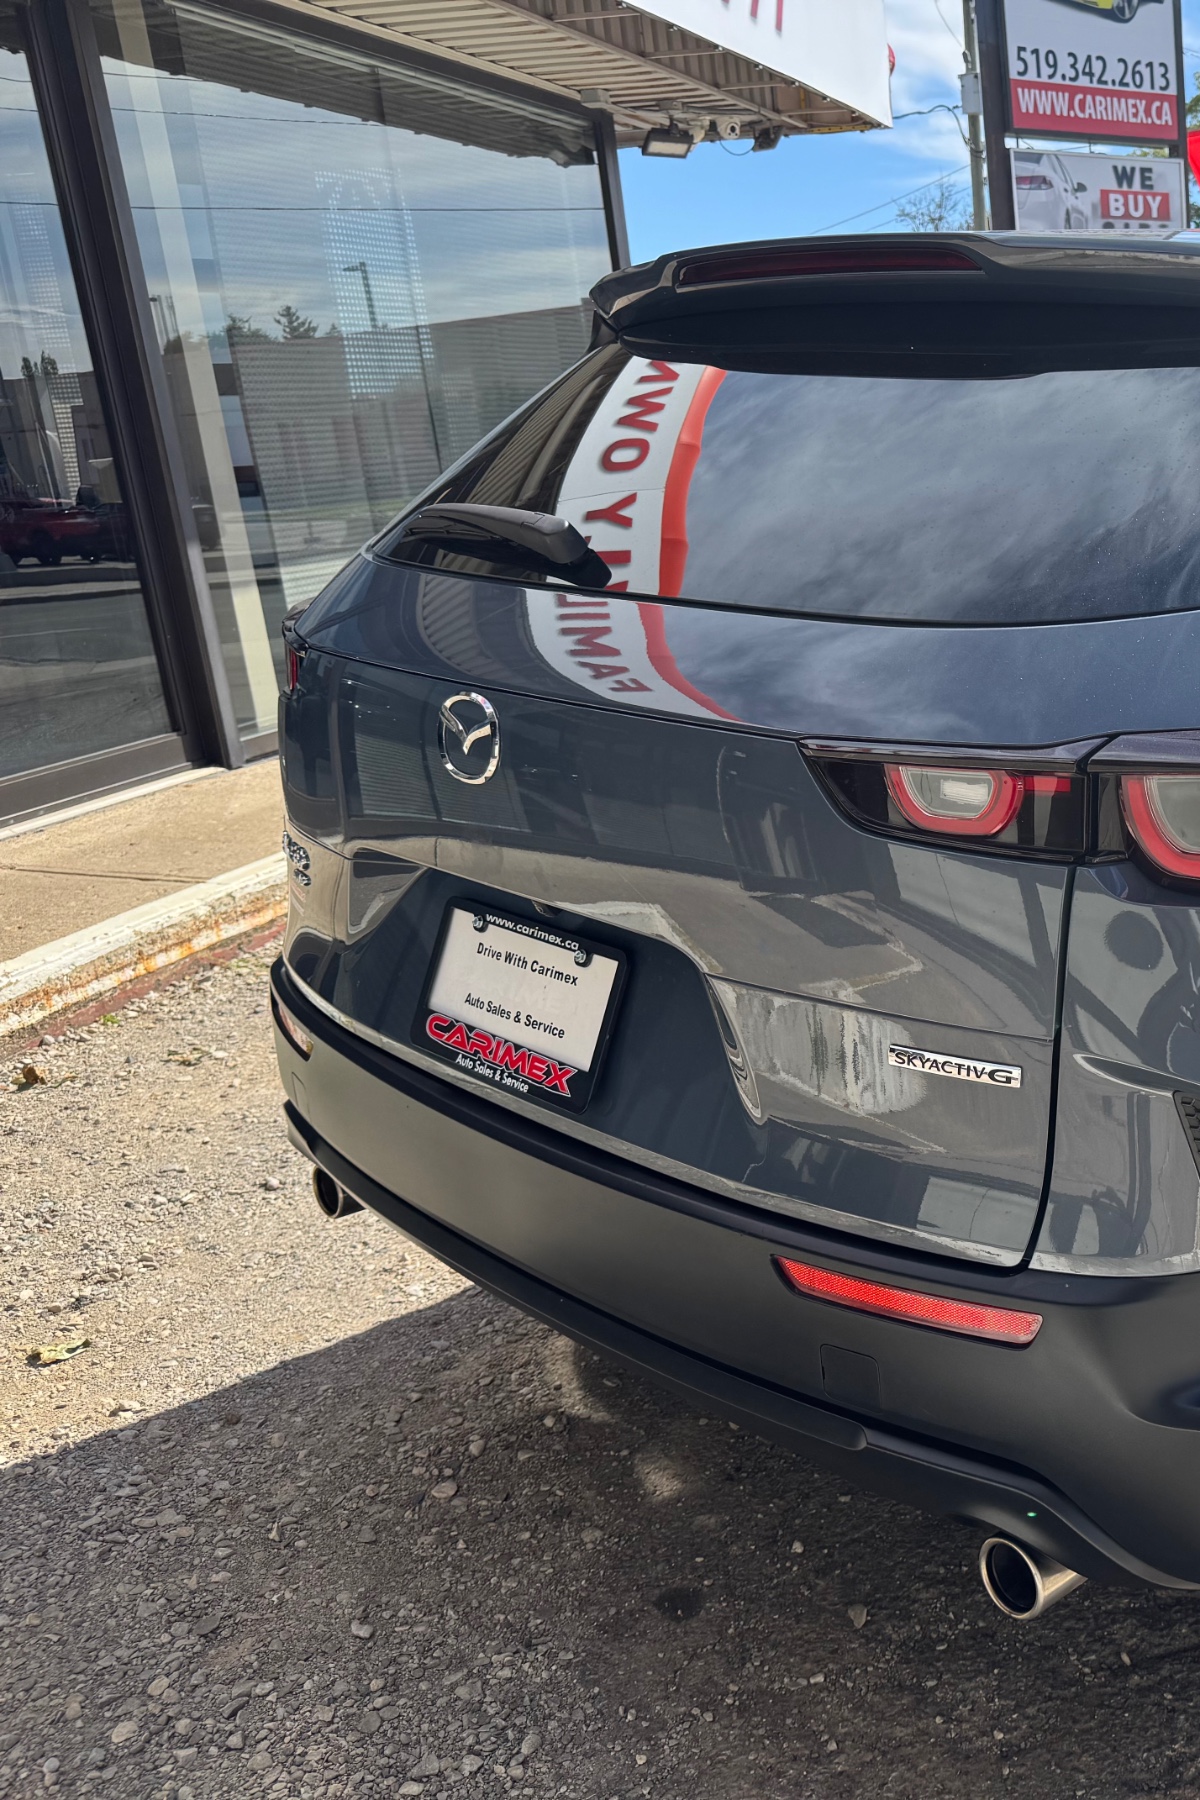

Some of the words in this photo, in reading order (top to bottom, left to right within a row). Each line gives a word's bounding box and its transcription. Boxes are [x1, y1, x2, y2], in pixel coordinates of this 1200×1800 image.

[1016, 45, 1170, 91] 519.342.2613
[1017, 87, 1172, 126] WWW.CARIMEX.CA
[1112, 165, 1154, 190] WE
[1108, 193, 1162, 218] BUY
[485, 913, 579, 951] www.carimex.ca
[476, 942, 502, 961] Drive
[504, 951, 528, 970] With
[530, 960, 579, 987] Carimex
[464, 992, 485, 1010] Auto
[486, 1001, 511, 1020] Sales
[513, 1010, 522, 1023] &
[524, 1014, 565, 1039] Service
[427, 1013, 577, 1096] CARIMEX
[455, 1053, 473, 1070] Auto
[474, 1061, 494, 1078] Sales
[495, 1068, 502, 1081] &
[502, 1072, 529, 1093] Service
